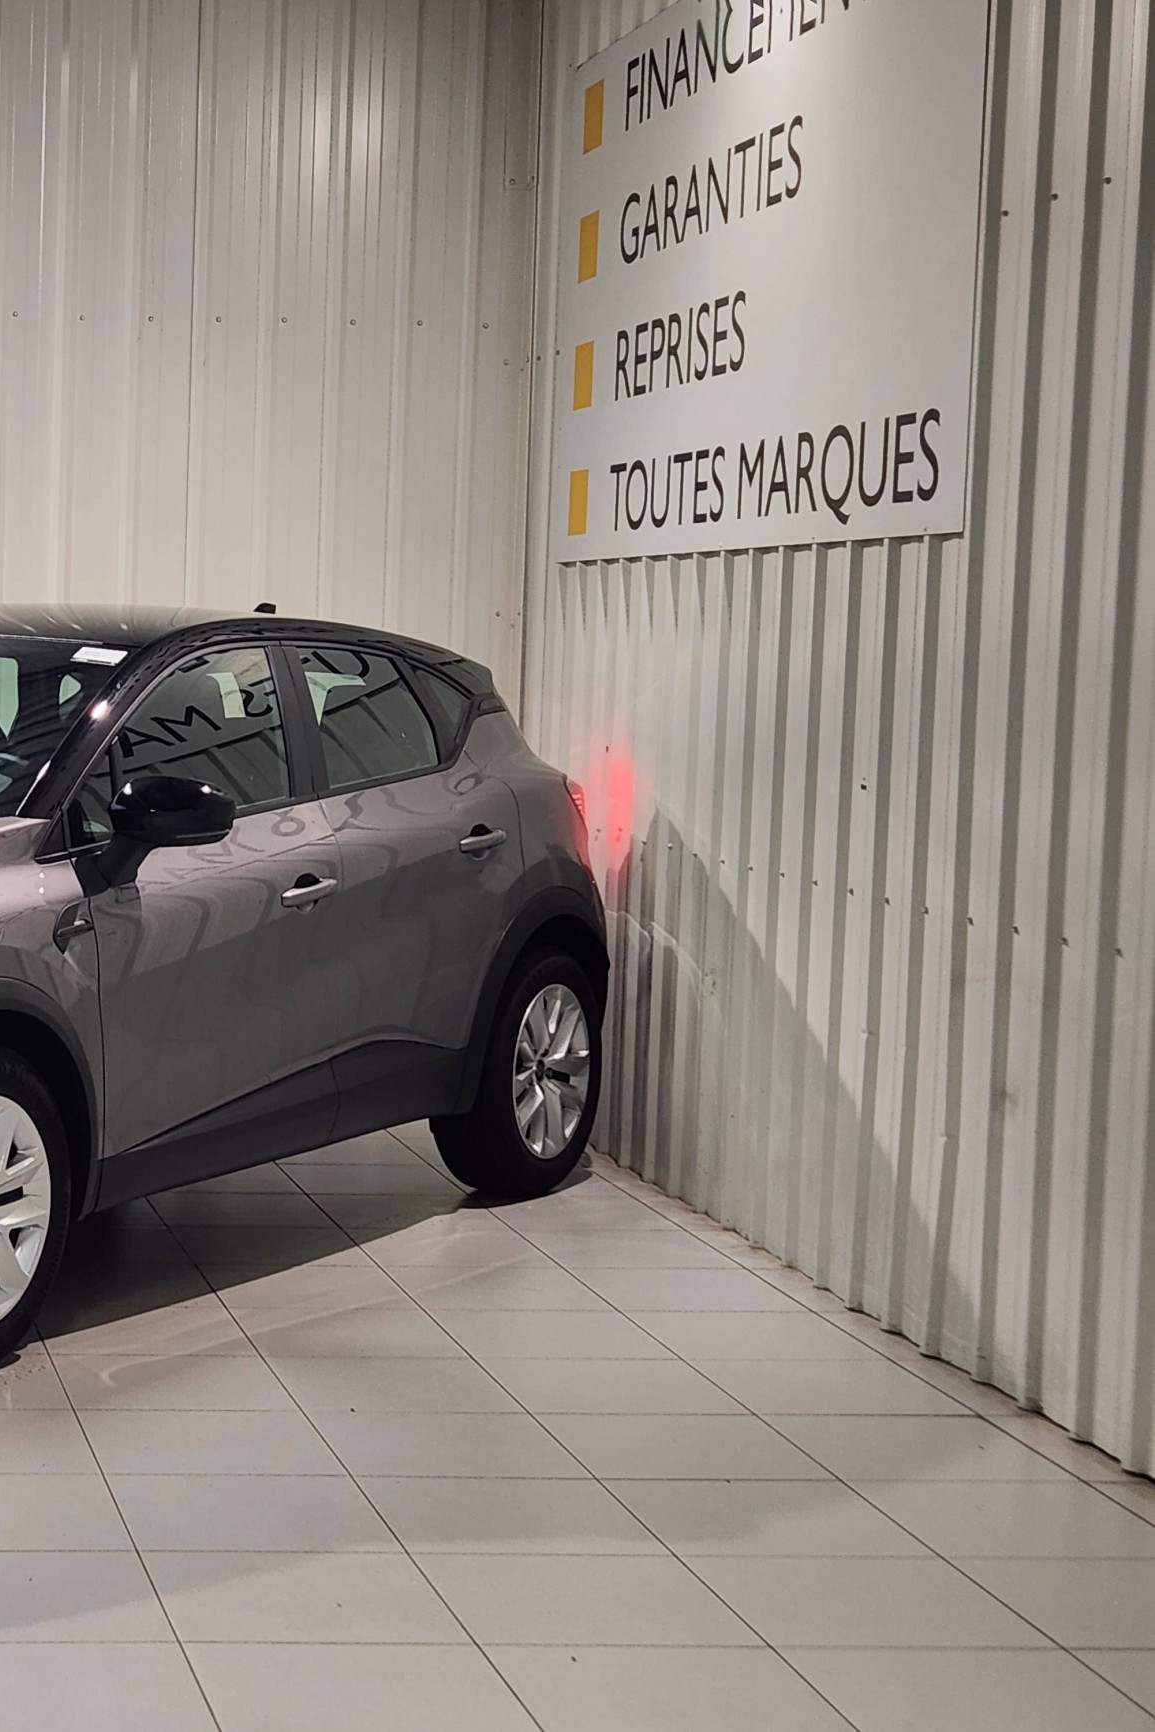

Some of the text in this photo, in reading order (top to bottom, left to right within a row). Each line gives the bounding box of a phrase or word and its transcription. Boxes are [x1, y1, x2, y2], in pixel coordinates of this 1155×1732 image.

[624, 0, 850, 132] FINANCEM
[620, 115, 804, 264] GARANTIES
[614, 290, 747, 401] REPRISES
[609, 407, 941, 532] TOUTES MARQUES
